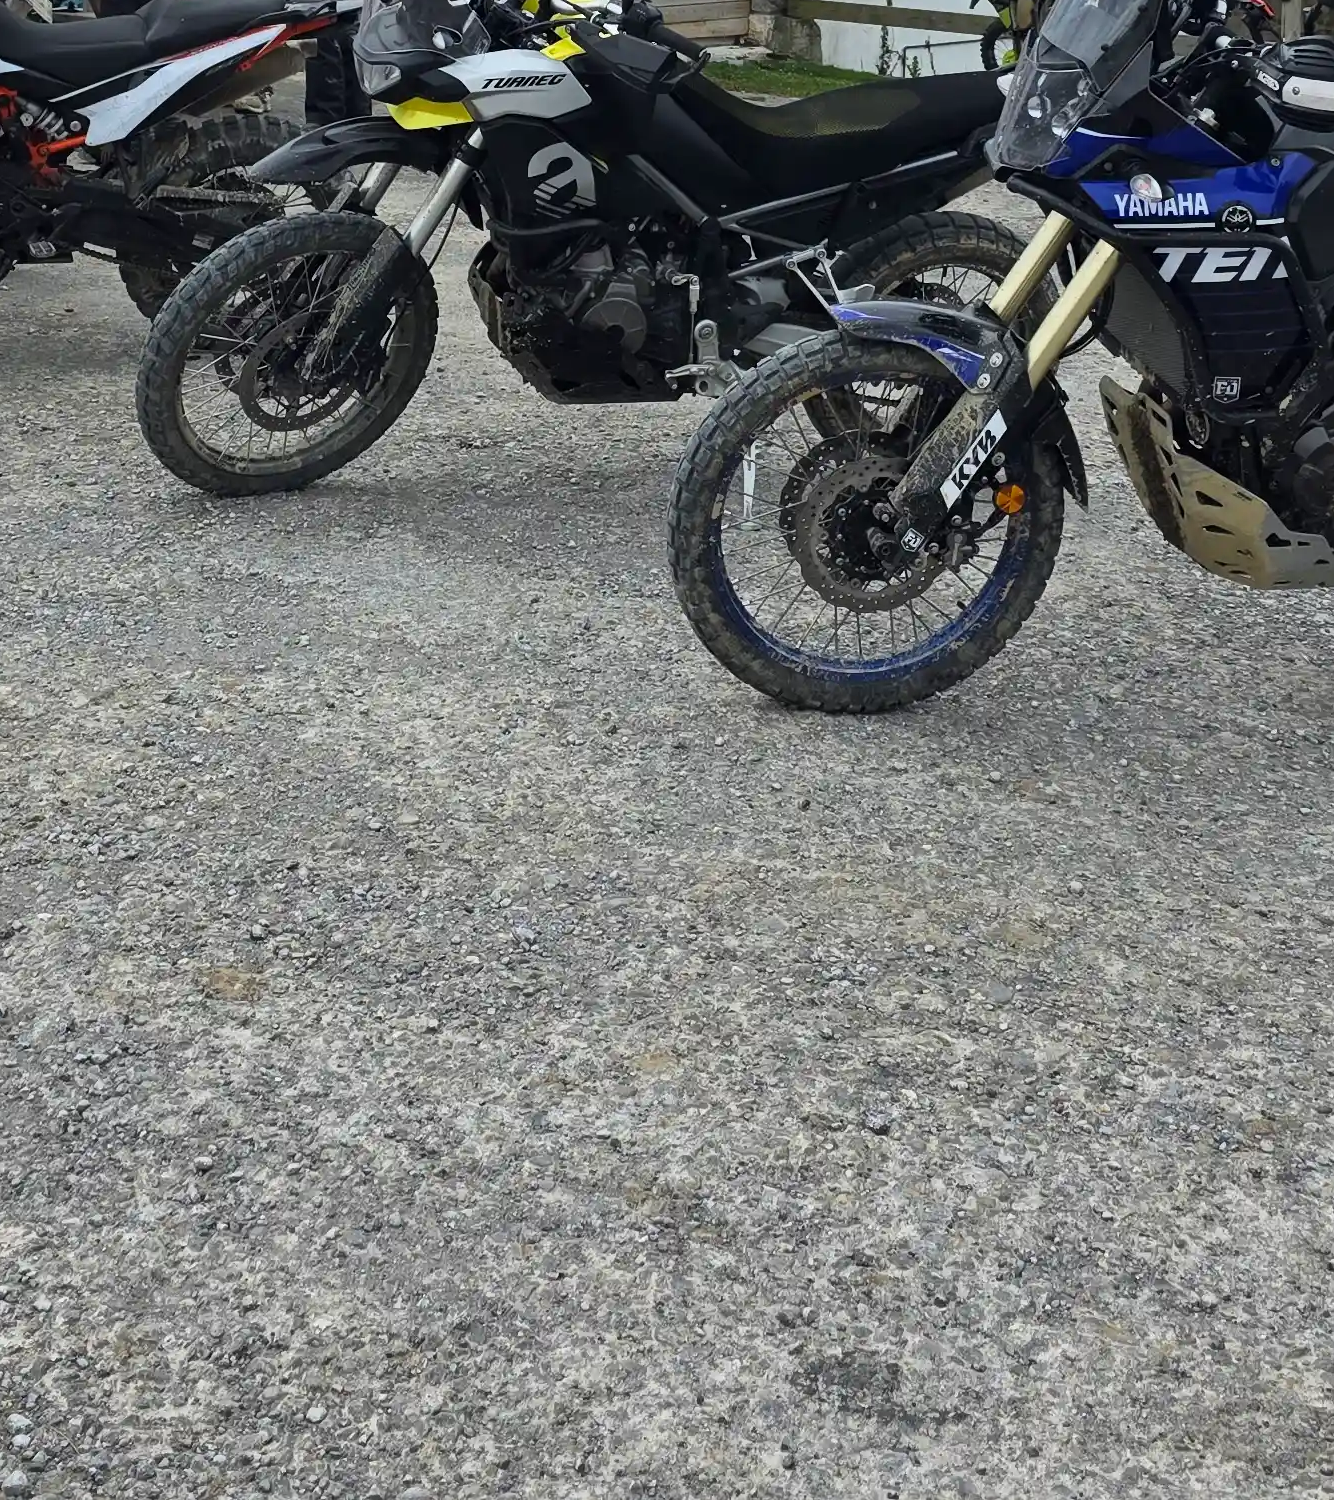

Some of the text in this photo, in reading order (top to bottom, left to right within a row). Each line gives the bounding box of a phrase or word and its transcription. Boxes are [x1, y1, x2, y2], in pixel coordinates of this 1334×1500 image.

[481, 73, 568, 90] TUAREG
[1113, 192, 1210, 217] YAMAHA
[951, 429, 996, 491] KYB
